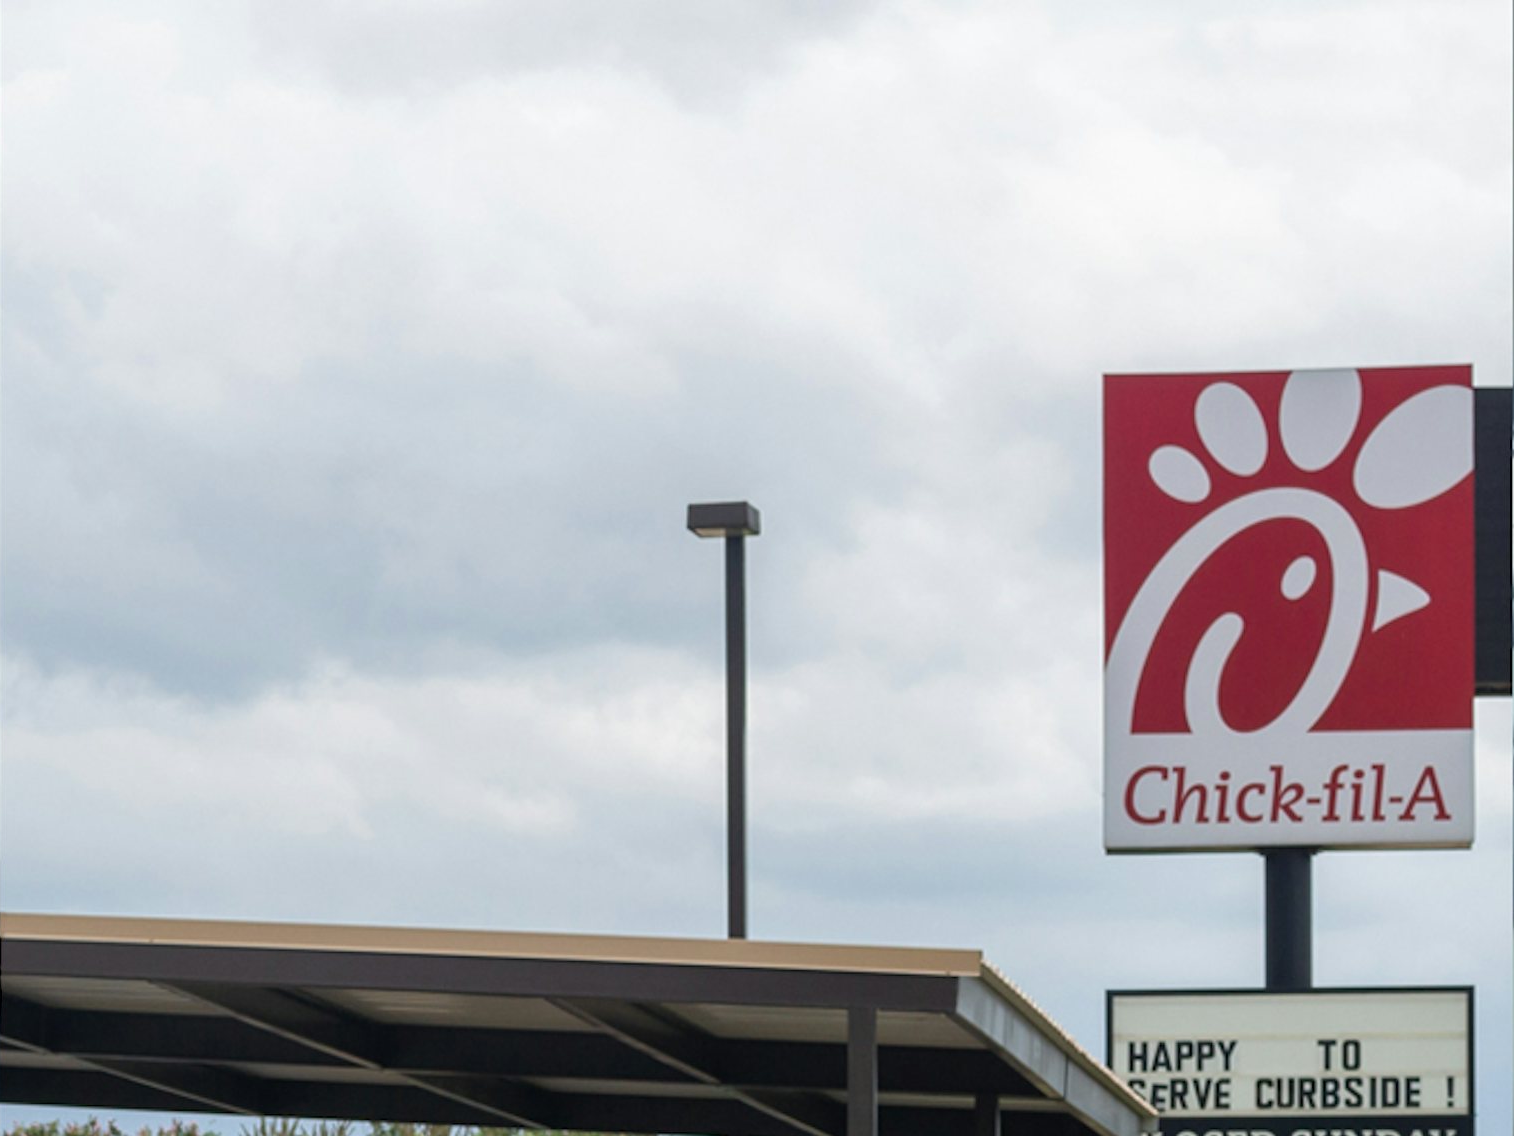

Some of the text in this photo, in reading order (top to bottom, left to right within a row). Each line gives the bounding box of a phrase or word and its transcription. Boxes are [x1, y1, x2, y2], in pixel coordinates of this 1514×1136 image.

[1123, 763, 1452, 826] Chick-fil-A
[1128, 1039, 1362, 1073] HAPPY TO
[1255, 1076, 1421, 1109] CURBSIDE
